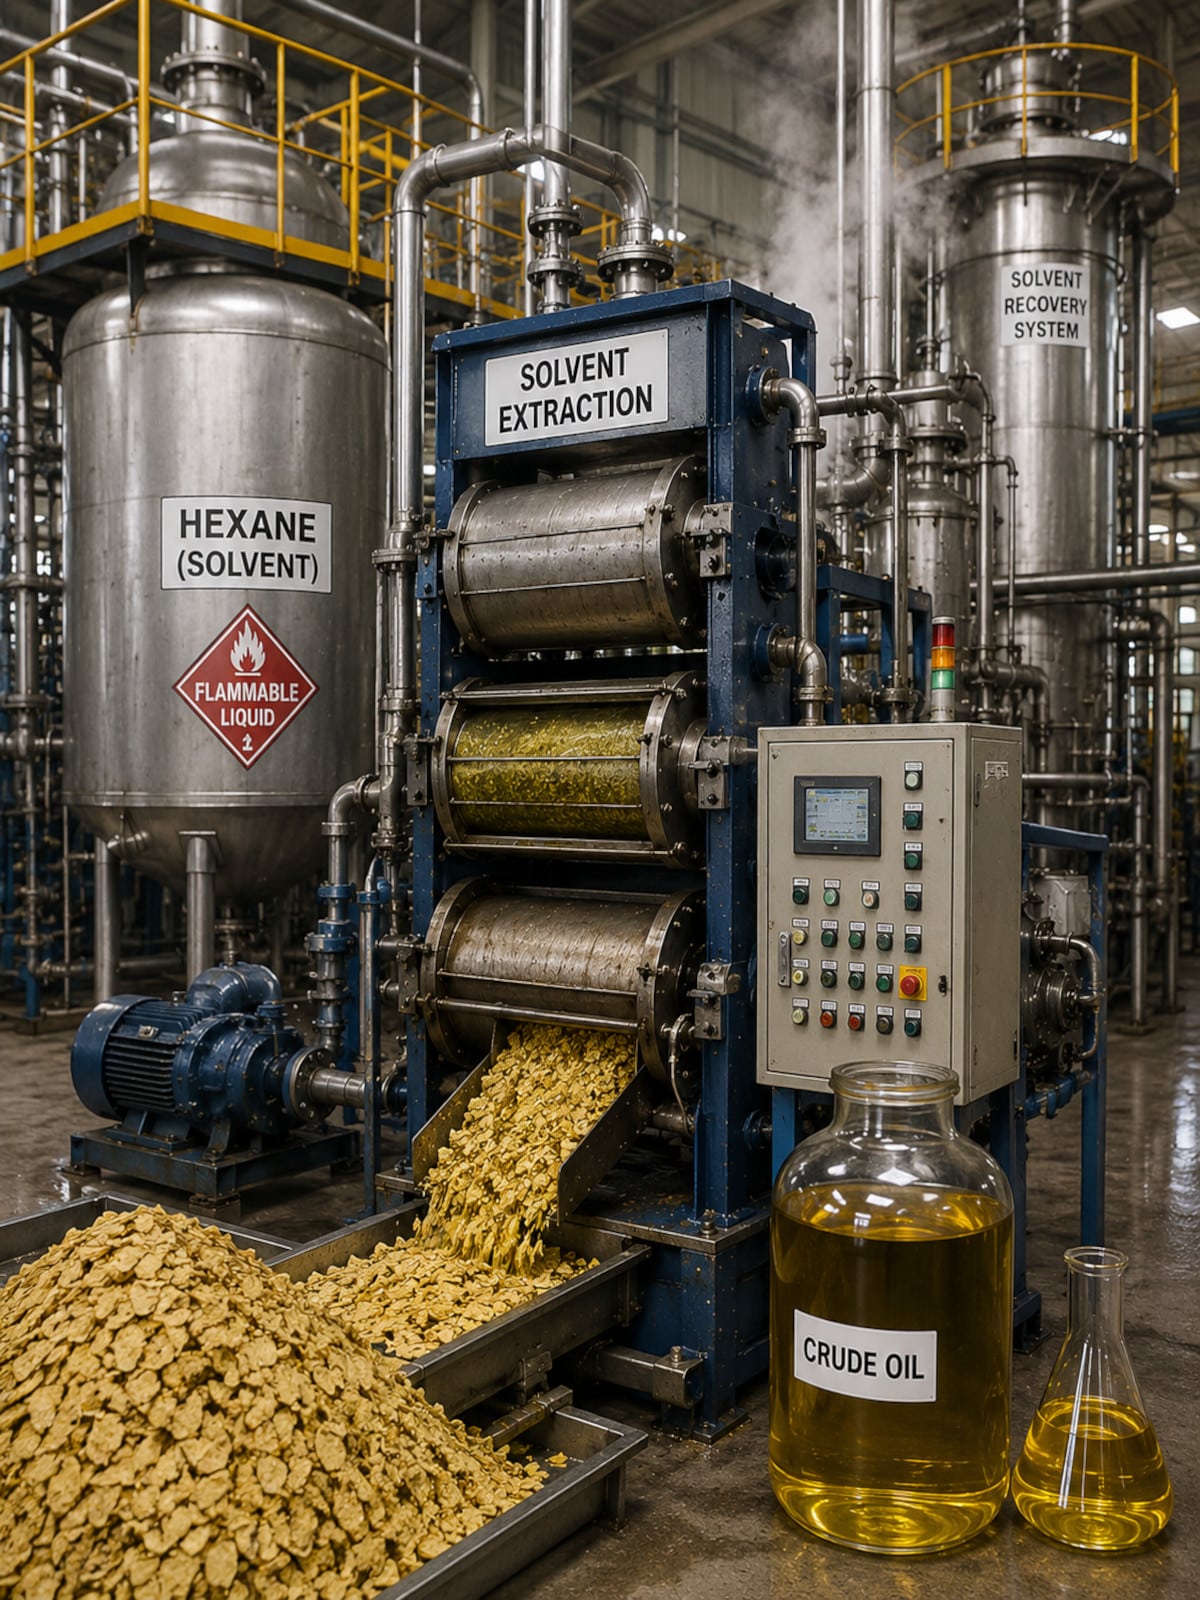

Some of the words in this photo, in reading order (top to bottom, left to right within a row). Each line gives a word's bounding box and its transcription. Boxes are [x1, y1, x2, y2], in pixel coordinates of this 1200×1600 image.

[1011, 269, 1083, 289] SOLVENT
[1004, 295, 1088, 316] RECOVERY
[1014, 320, 1079, 340] SYSTEM
[520, 346, 630, 392] SOLVENT
[499, 383, 652, 434] EXTRACTION
[180, 508, 316, 544] HEXANE
[177, 549, 319, 585] (SOLVENT)
[195, 682, 299, 702] FLAMMABLE
[221, 708, 275, 727] LIQUID
[803, 1336, 877, 1377] CRUDE
[885, 1353, 925, 1380] OIL
